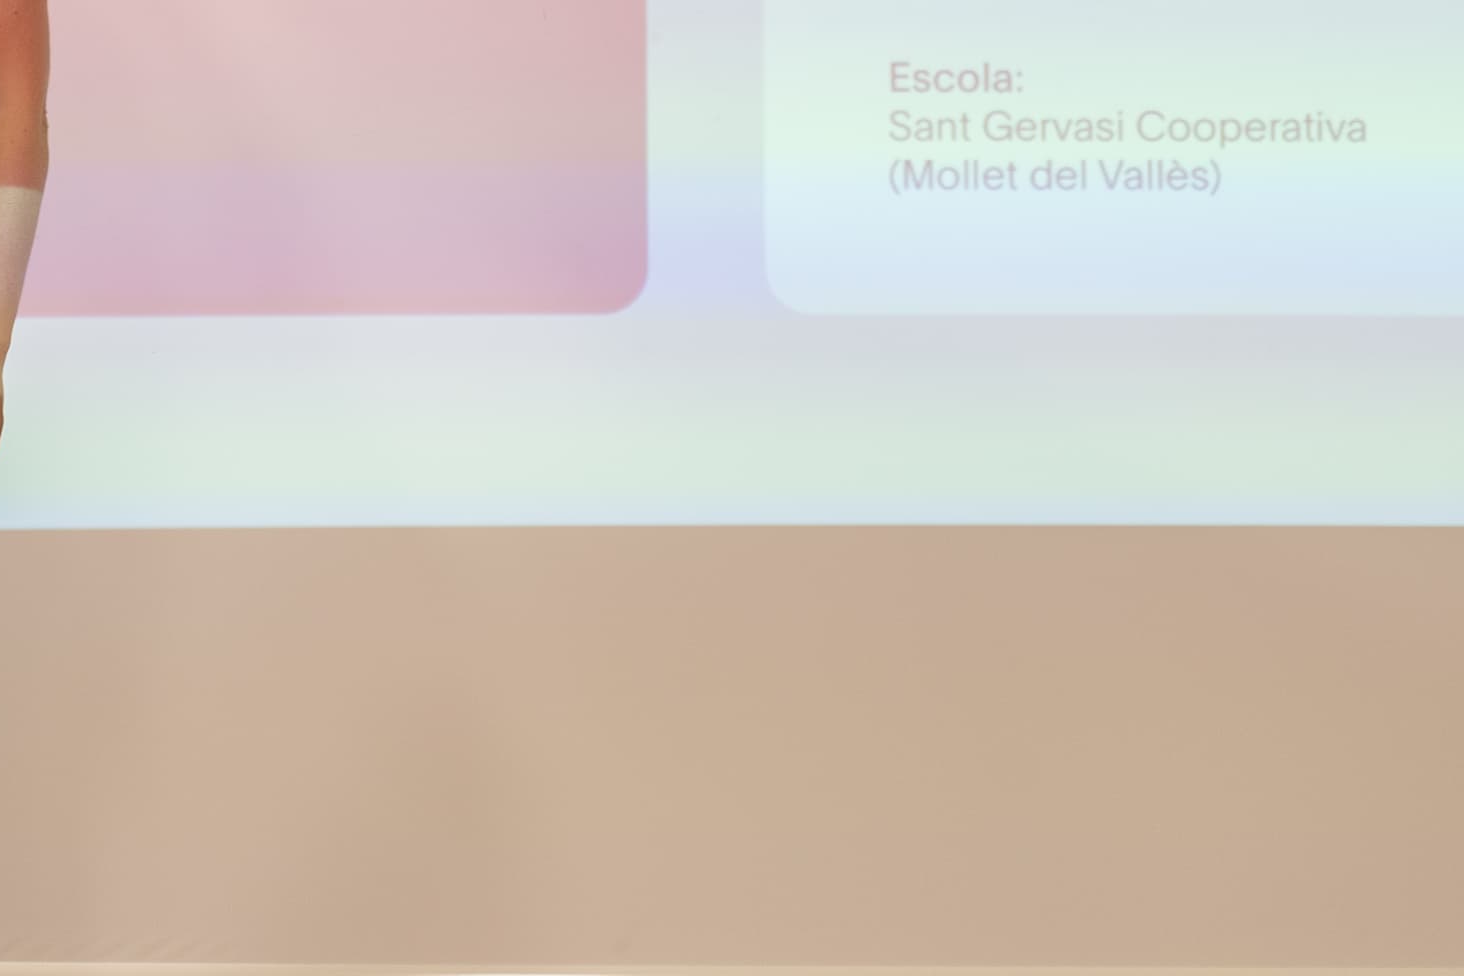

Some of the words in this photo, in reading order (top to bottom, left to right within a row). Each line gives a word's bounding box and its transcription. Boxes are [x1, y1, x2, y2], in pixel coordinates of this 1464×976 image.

[890, 62, 1023, 93] Escola:
[890, 110, 971, 142] Sant
[984, 110, 1123, 142] Gervasi
[1137, 110, 1367, 148] Cooperativa
[890, 160, 1018, 195] (Mollet
[1031, 159, 1086, 191] del
[1099, 159, 1221, 196] Vallès)
